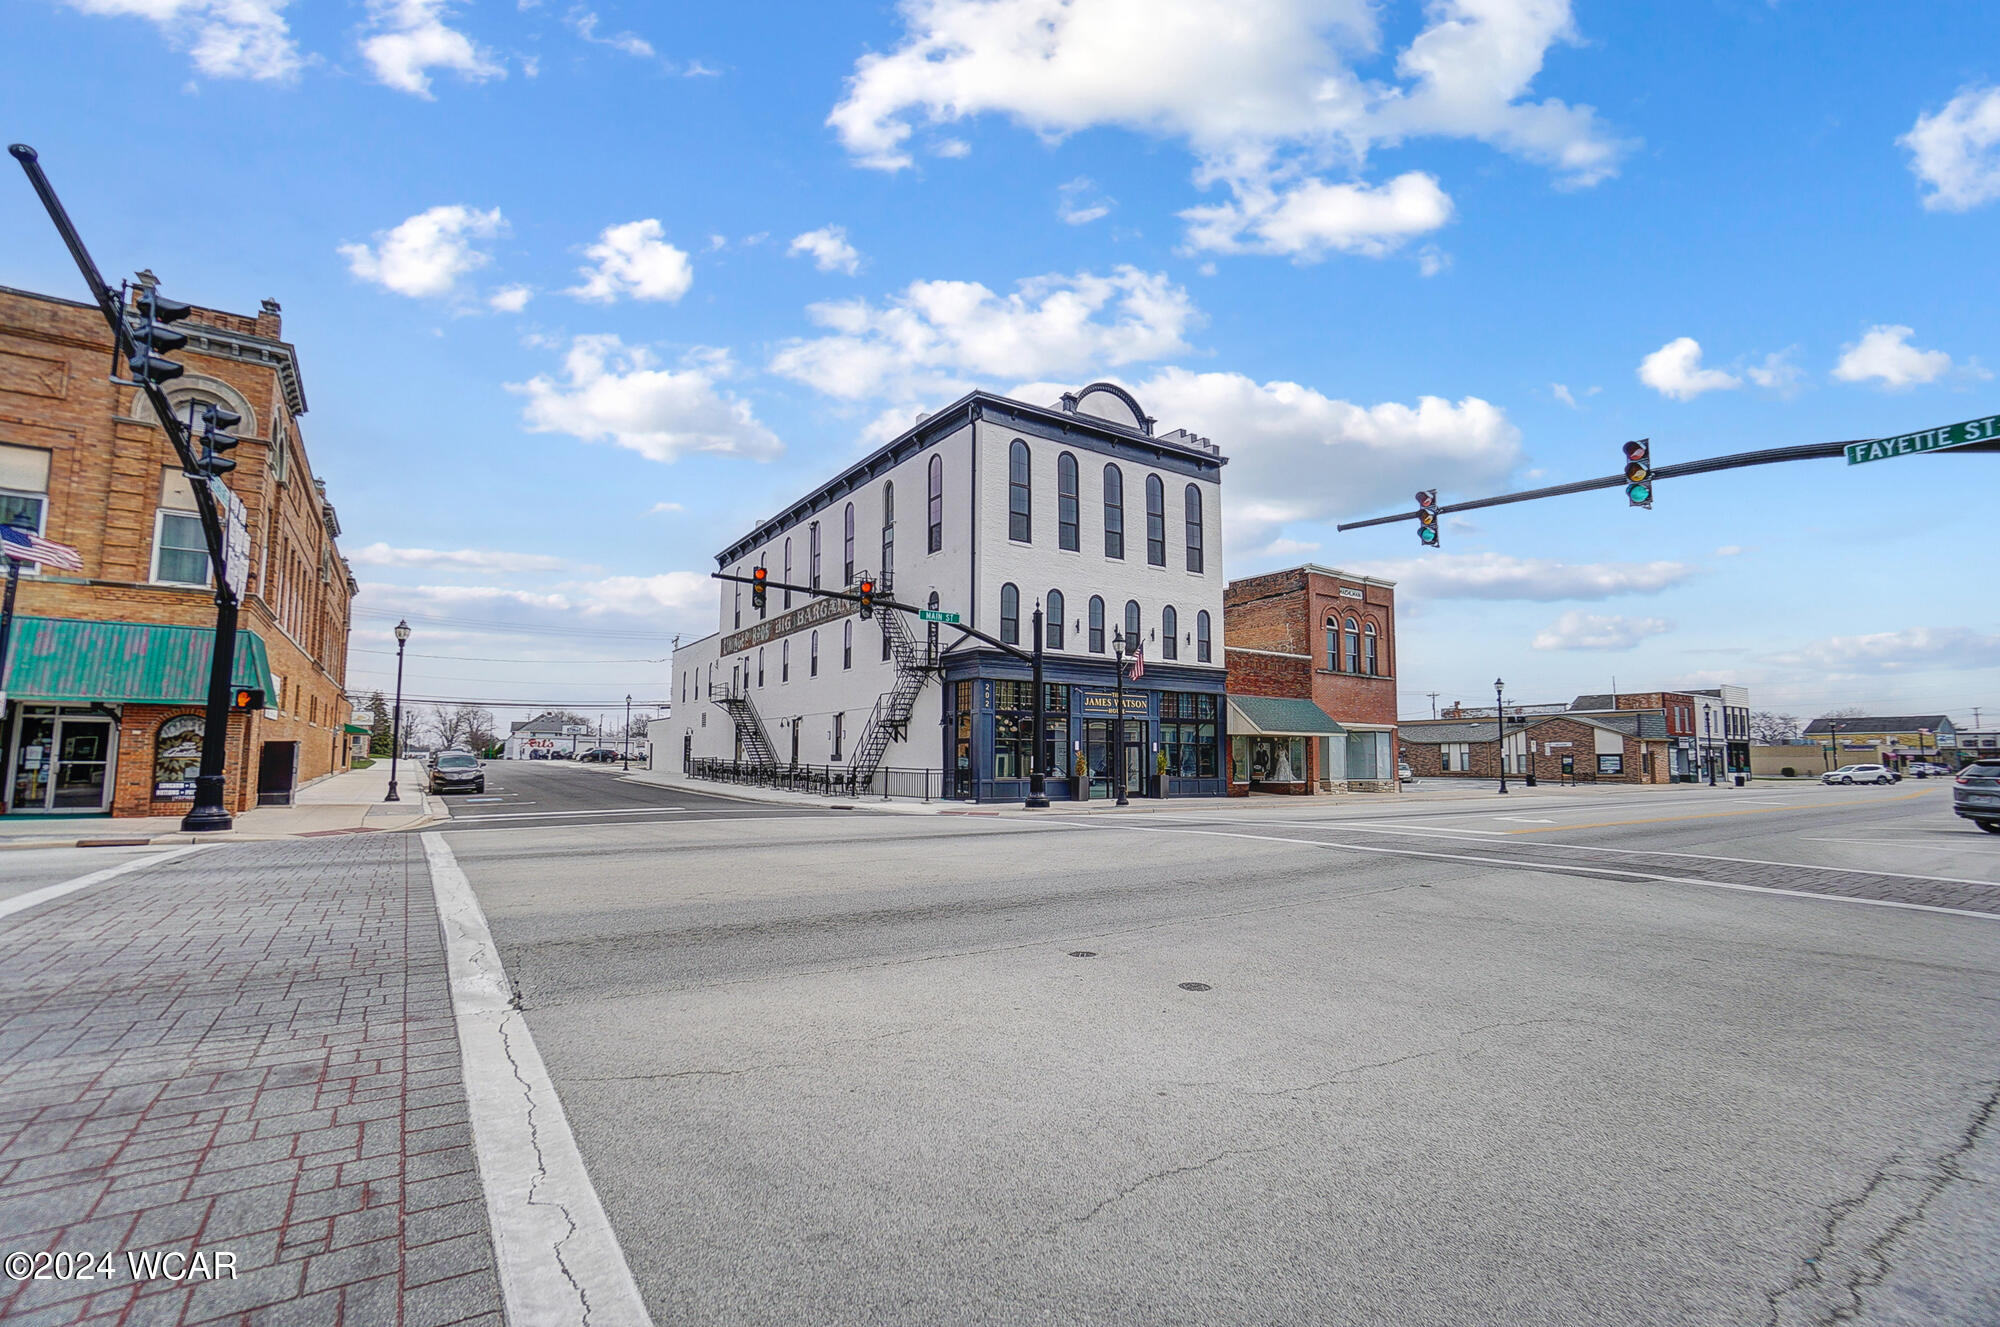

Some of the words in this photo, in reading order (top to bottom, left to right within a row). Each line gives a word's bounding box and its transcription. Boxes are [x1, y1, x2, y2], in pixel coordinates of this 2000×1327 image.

[1855, 427, 1953, 463] FAYETTE
[1964, 418, 1996, 440] ST
[925, 611, 943, 621] MAIN
[945, 614, 954, 622] ST
[1084, 698, 1112, 707] JAMES
